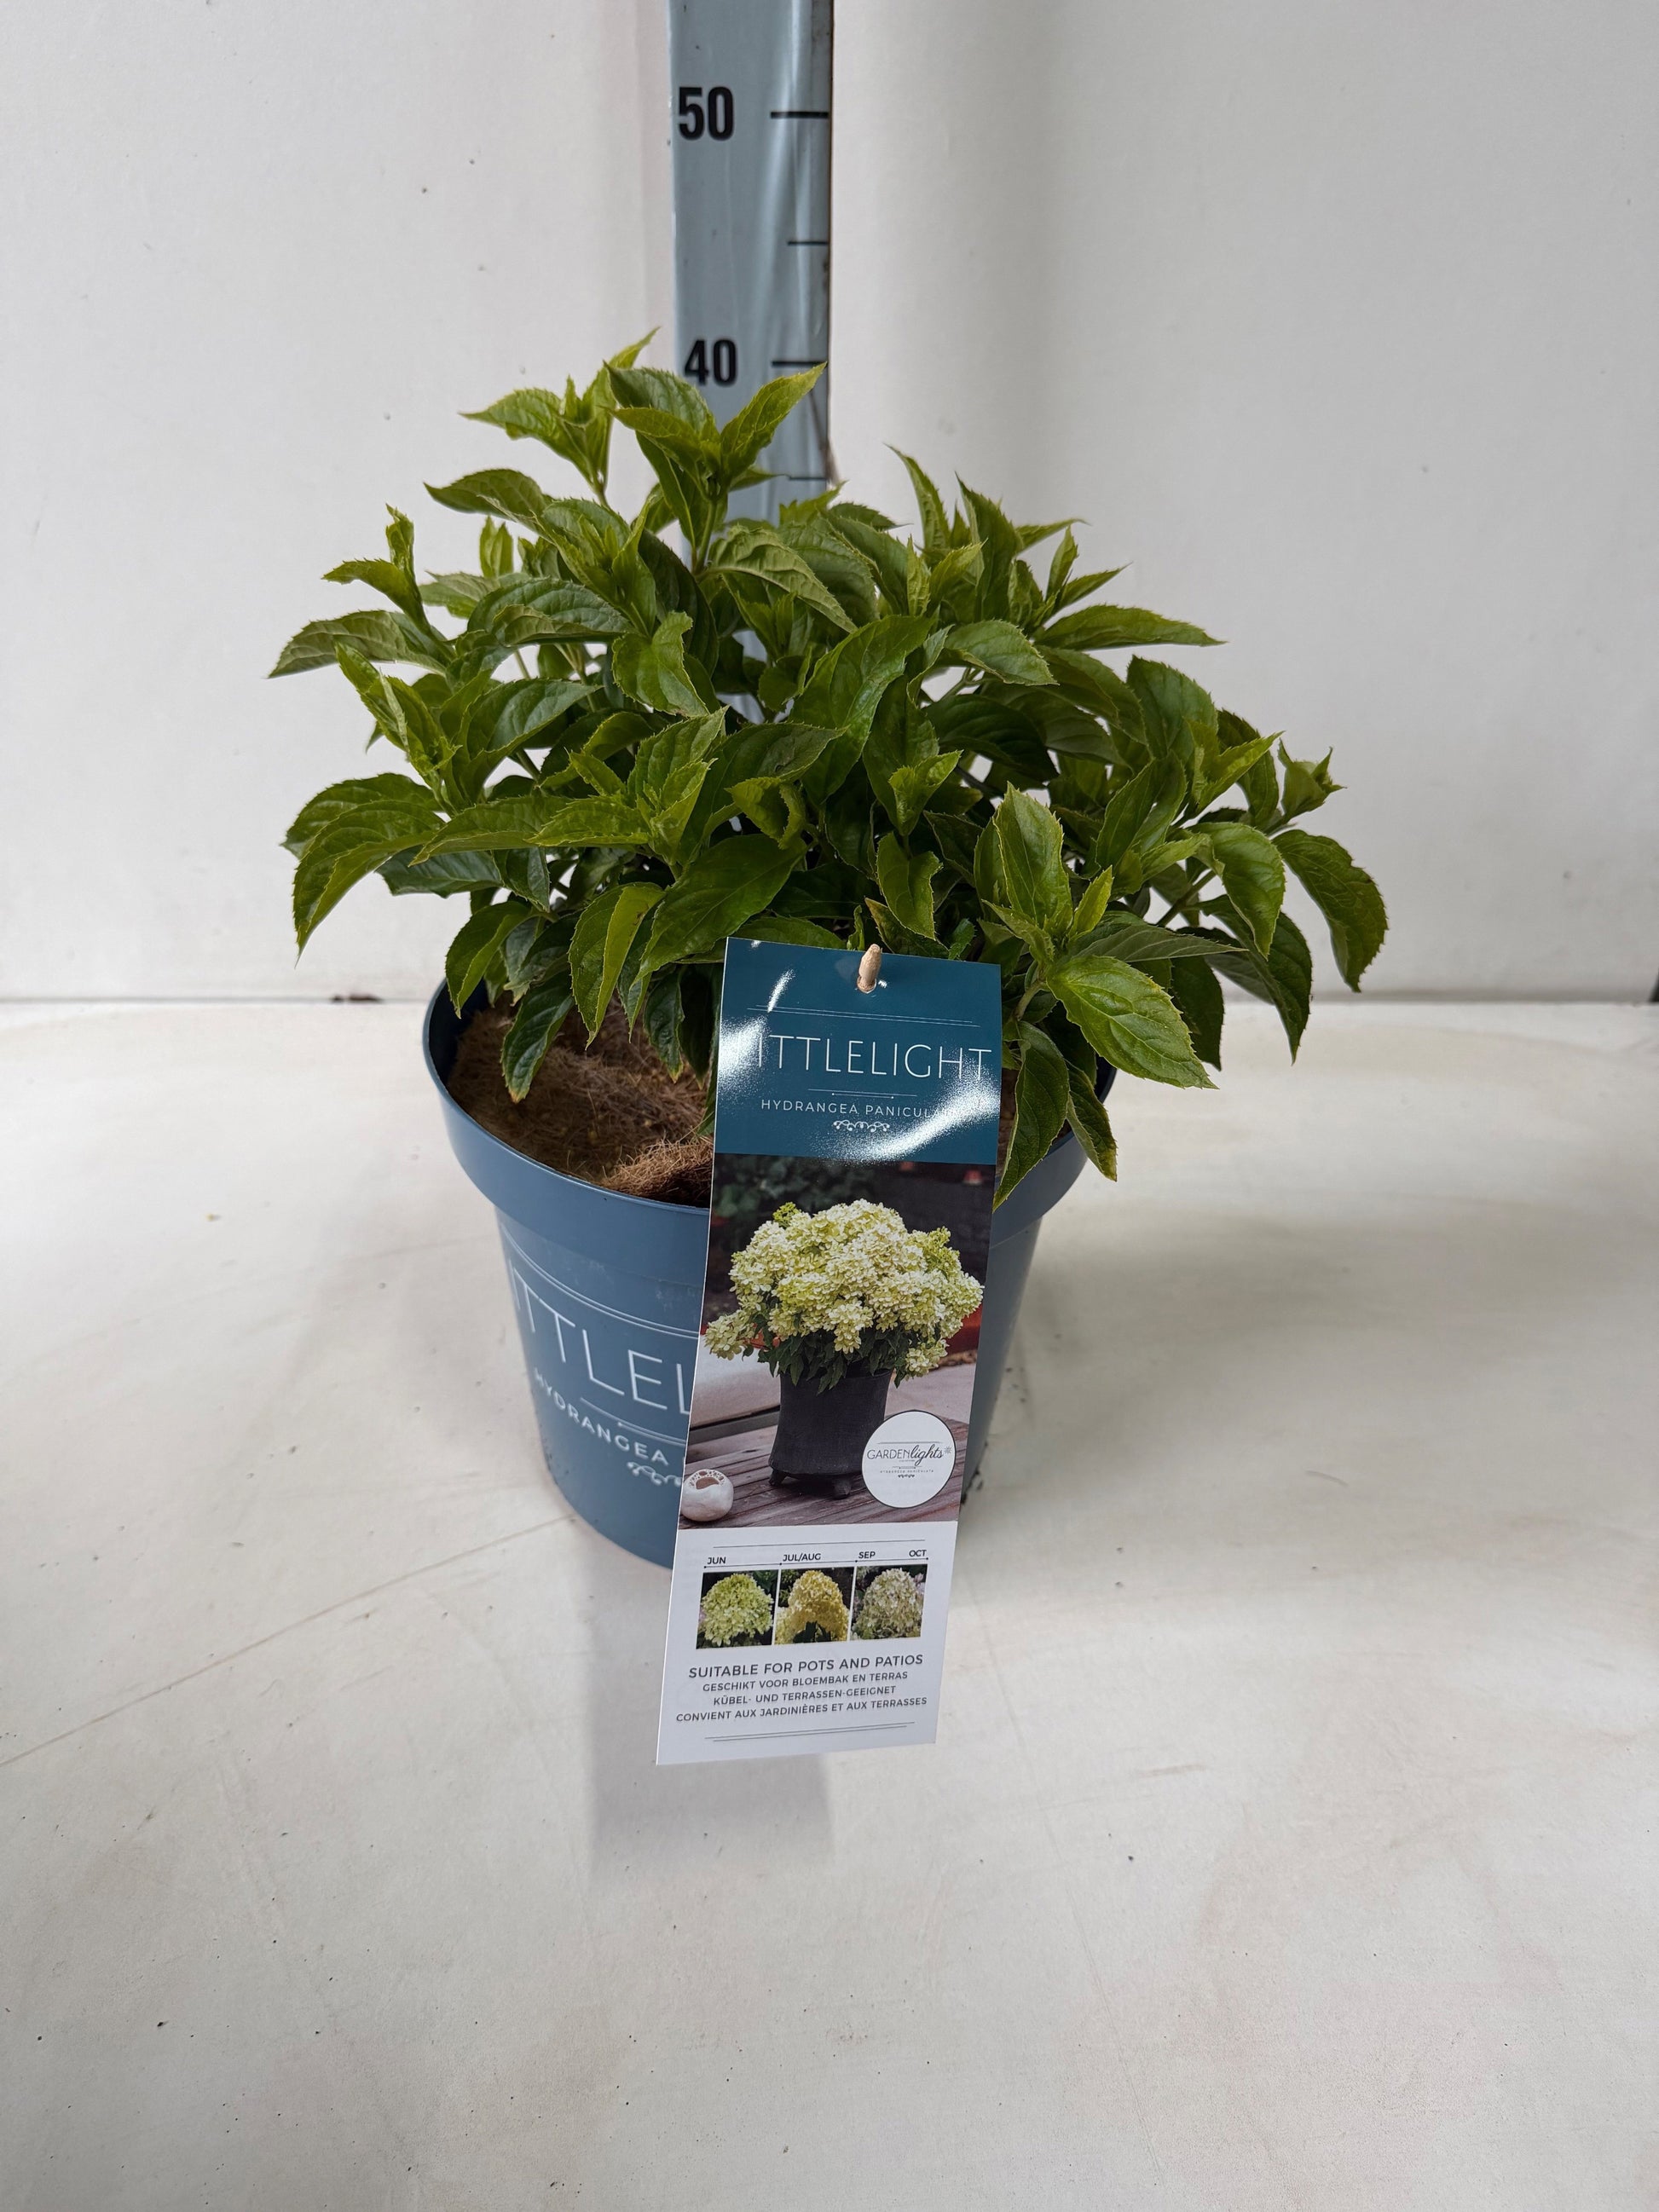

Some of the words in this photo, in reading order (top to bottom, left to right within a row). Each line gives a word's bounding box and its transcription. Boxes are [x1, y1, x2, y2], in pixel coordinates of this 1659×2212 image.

[679, 86, 734, 141] 50
[685, 338, 737, 386] 40
[738, 1032, 992, 1079] ITTLELIGHT
[761, 1099, 858, 1115] HYDRANGEA
[865, 1105, 950, 1119] PANICUL
[508, 1260, 691, 1415] ITTLEL
[534, 1366, 668, 1466] HYDRANGEA
[867, 1444, 944, 1466] GARDENlights
[707, 1556, 726, 1565] JUN
[783, 1553, 821, 1562] JUL/AUG
[688, 1664, 759, 1678] SUITABLE
[764, 1661, 793, 1674] FOR
[798, 1659, 835, 1672] POTS
[839, 1657, 870, 1669] AND
[875, 1654, 923, 1667] PATIOS
[702, 1681, 756, 1692] GESCHIKT
[759, 1678, 789, 1689] VOOR
[792, 1676, 849, 1687] BLOEMBAK
[853, 1674, 866, 1683] EN
[870, 1672, 908, 1681] TERRAS
[714, 1695, 752, 1706] KÜBEL-
[755, 1693, 778, 1703] UND
[782, 1685, 896, 1701] TERRASSEN-GEEIGNET
[676, 1711, 731, 1722] CONVIENT
[734, 1708, 757, 1718] AUX
[760, 1703, 828, 1717] JARDINIÈRES
[831, 1703, 844, 1712] ET
[846, 1701, 868, 1711] AUX
[870, 1697, 928, 1709] TERRASSES
